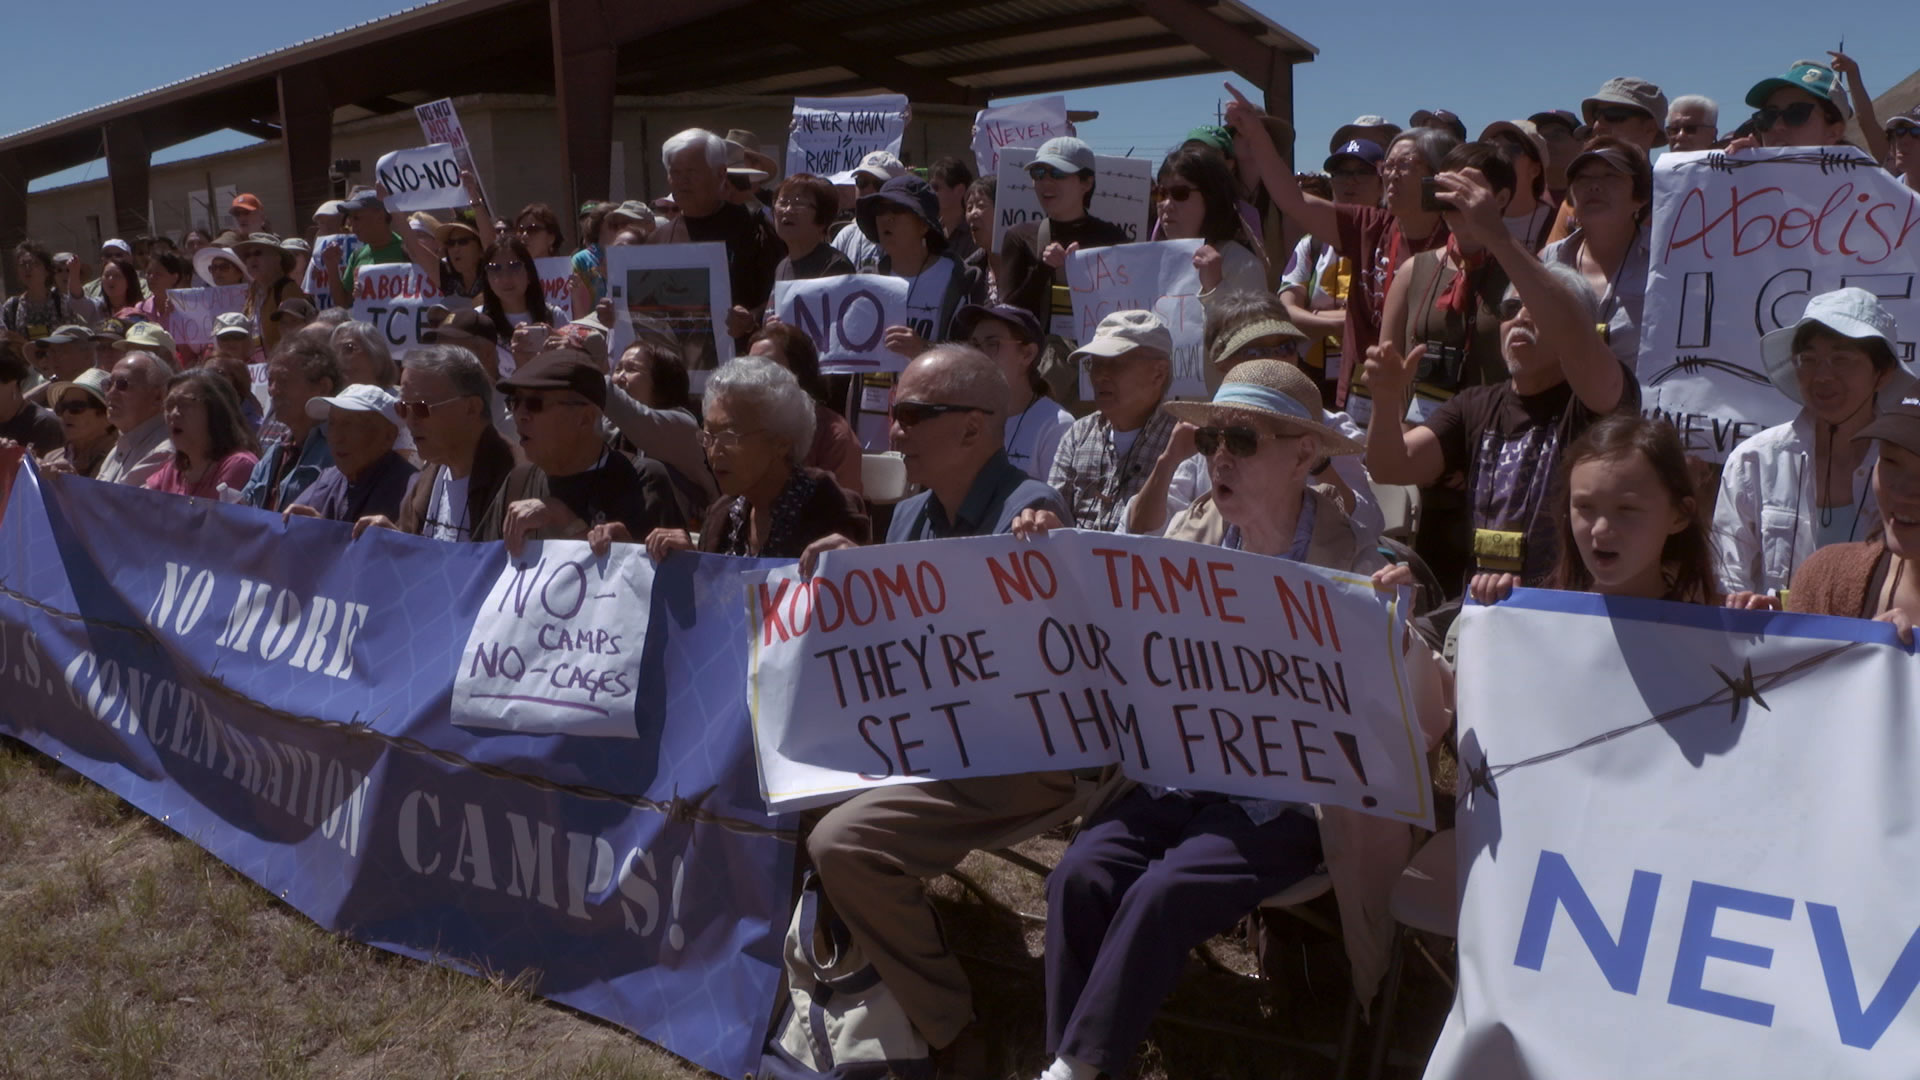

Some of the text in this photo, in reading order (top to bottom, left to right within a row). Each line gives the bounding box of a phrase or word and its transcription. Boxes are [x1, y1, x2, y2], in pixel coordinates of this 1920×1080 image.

[803, 109, 887, 135] NEVER AGAIN
[985, 120, 1056, 149] NEVER
[806, 144, 877, 173] RIGHT NO
[838, 134, 852, 149] IS
[1347, 140, 1360, 152] LA
[380, 159, 461, 196] NO-NO
[1001, 208, 1027, 226] NO
[361, 272, 444, 301] ABOLIS
[541, 274, 575, 299] MPS
[1071, 253, 1132, 292] JAs
[794, 289, 885, 353] NO
[760, 548, 1343, 652] KODOMO NO TAME NI
[146, 562, 369, 680] NO MORE
[538, 623, 622, 655] CAMPS
[814, 617, 1352, 715] THEY'RE OUR CHILDREN
[857, 701, 971, 782] SET
[1178, 705, 1378, 809] FREE!
[397, 790, 687, 951] CAMPS!
[1513, 849, 1920, 1051] NEV
